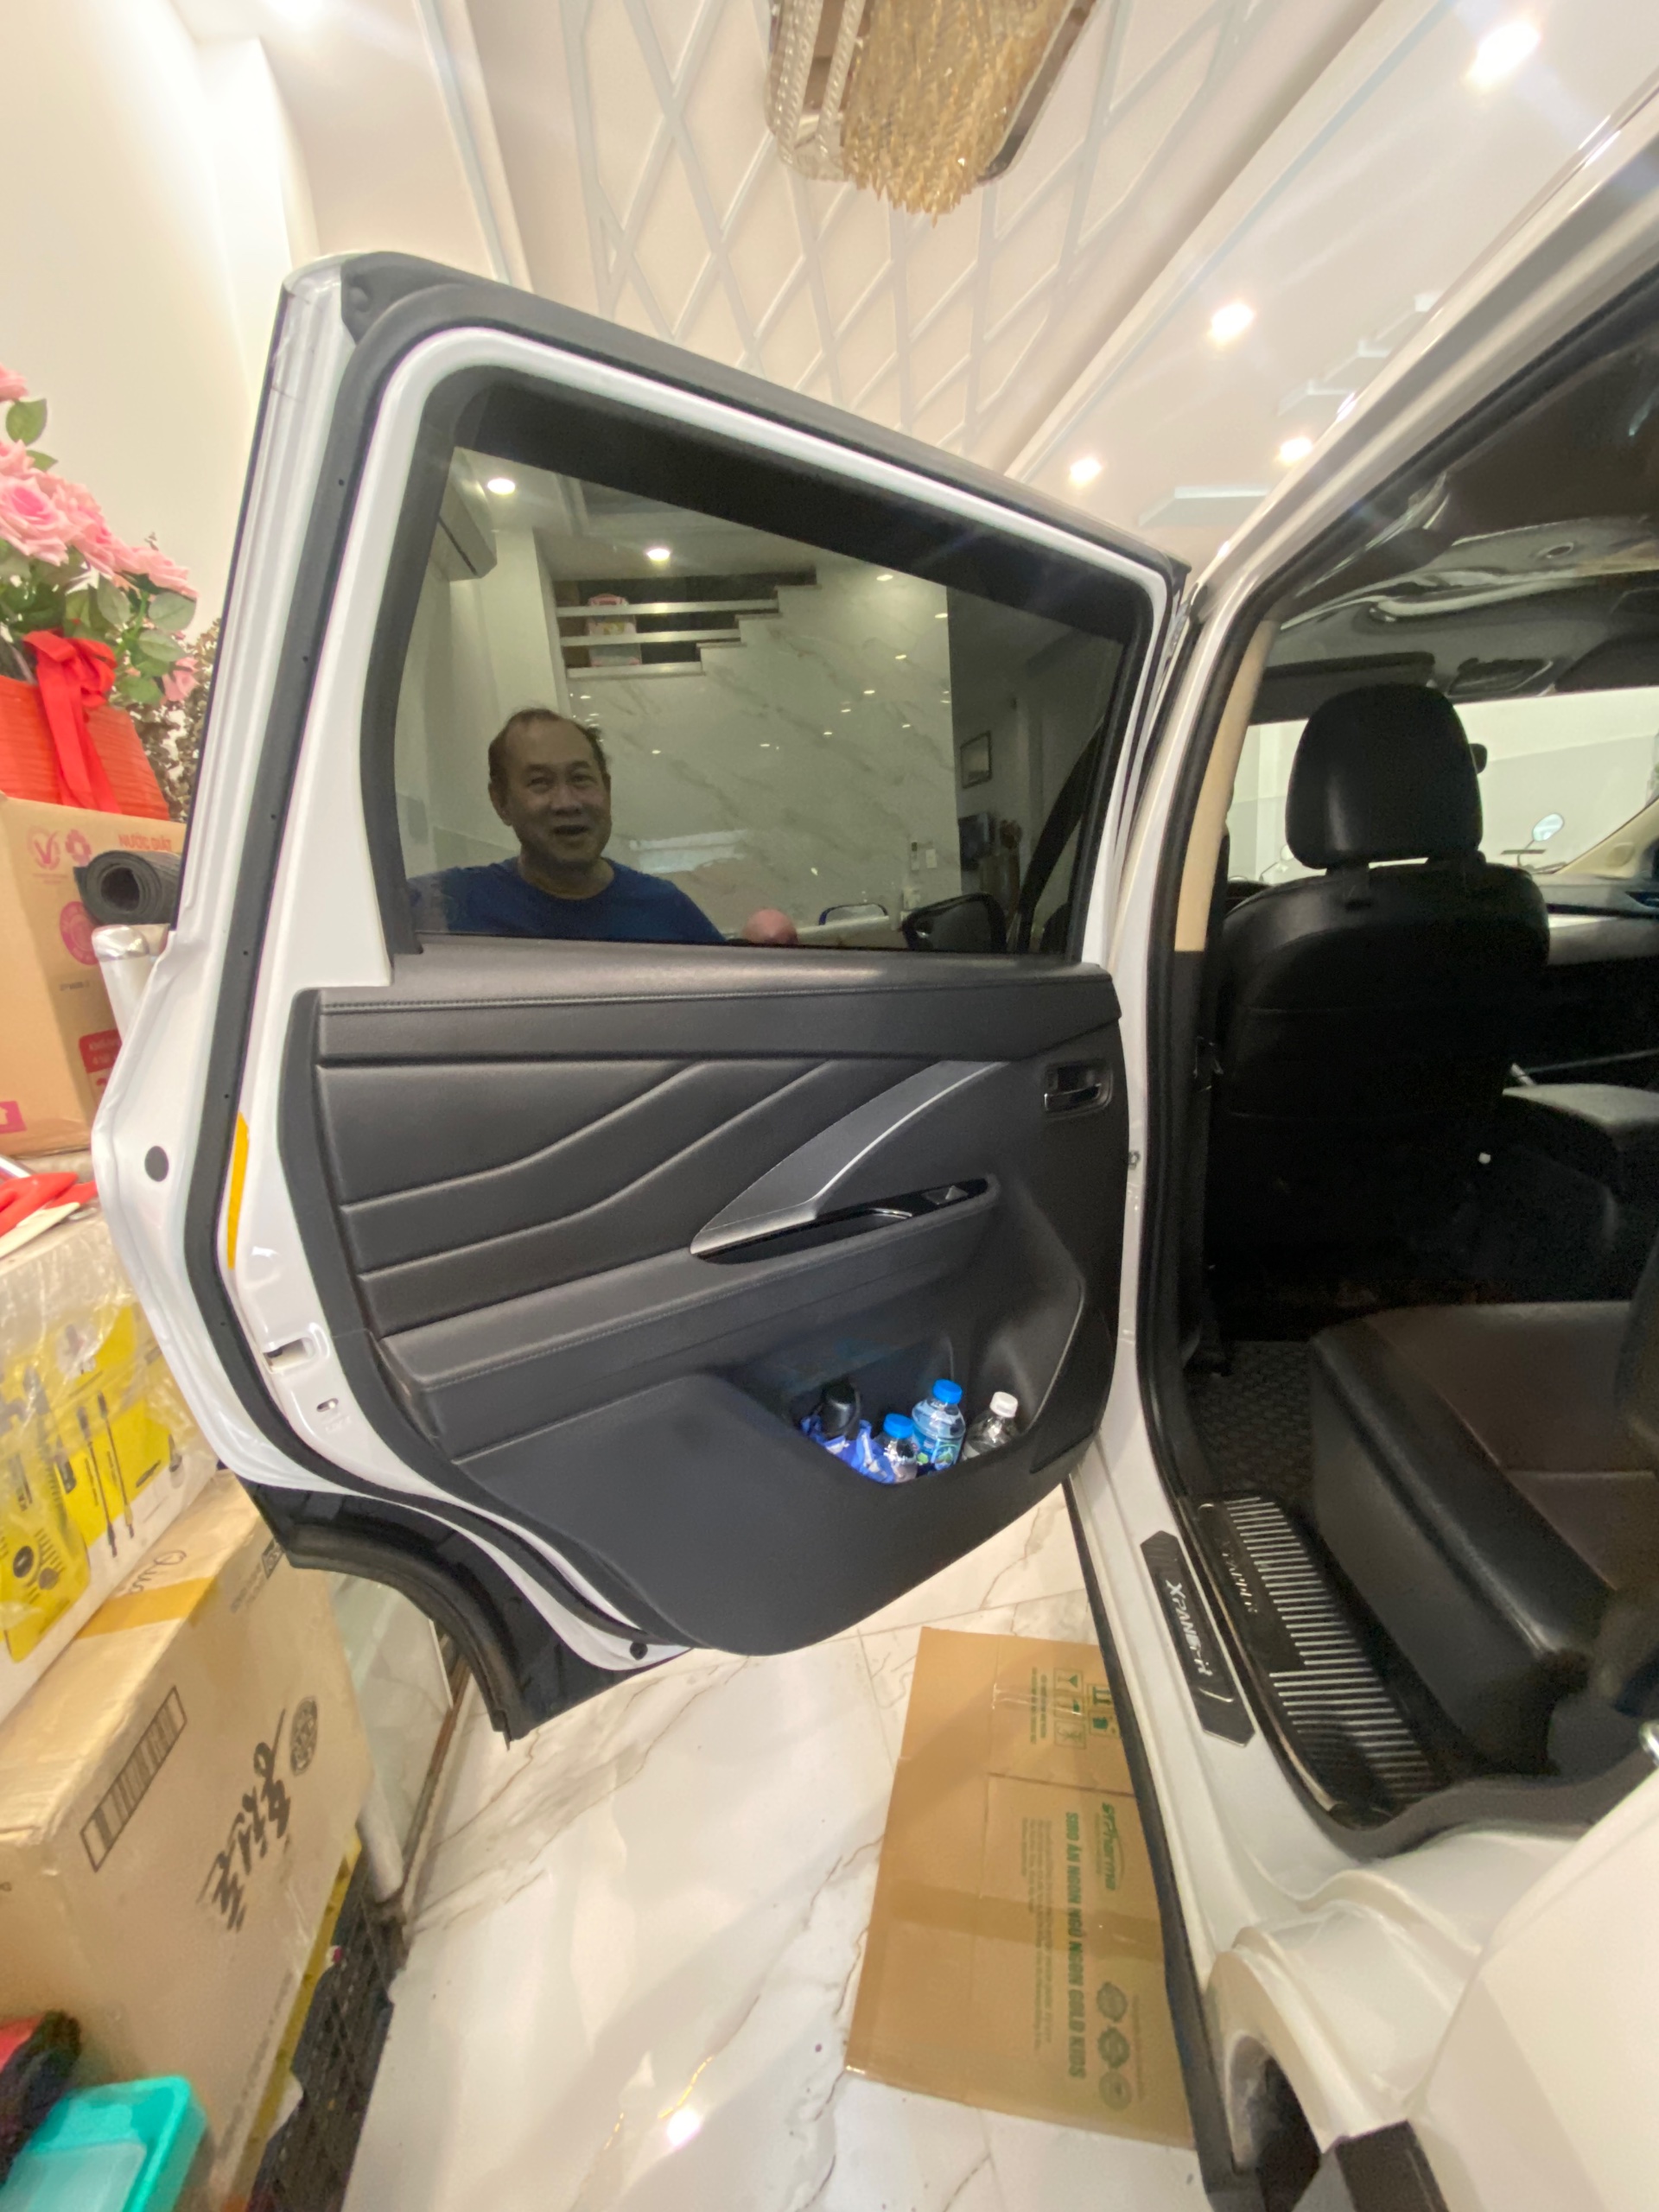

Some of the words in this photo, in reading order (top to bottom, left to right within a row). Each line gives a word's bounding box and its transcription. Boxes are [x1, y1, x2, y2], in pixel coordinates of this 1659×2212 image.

[1068, 1866, 1081, 1904] NGON
[1069, 1941, 1083, 1986] NGON
[1069, 1990, 1085, 2033] GOLD
[1069, 2036, 1086, 2079] KIDS
